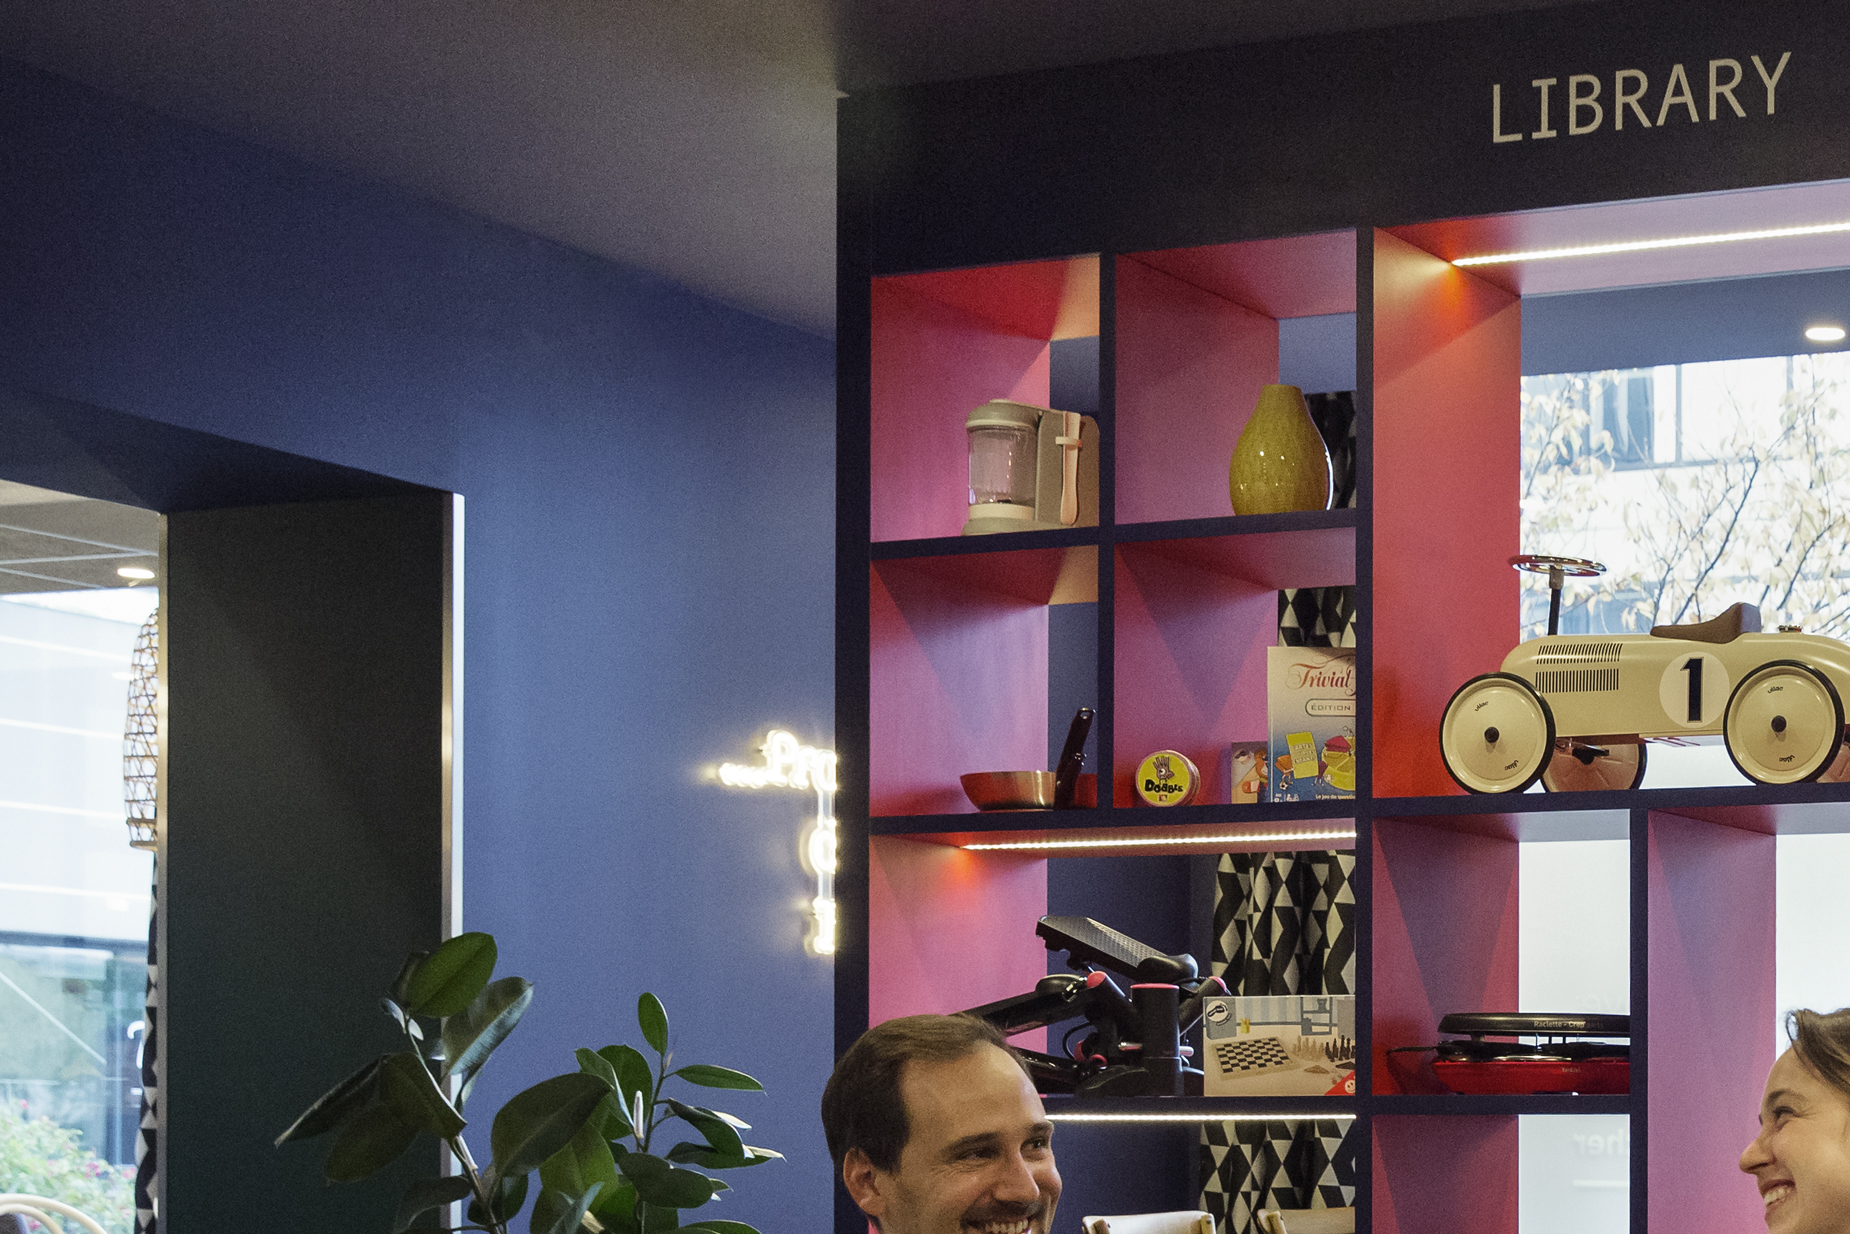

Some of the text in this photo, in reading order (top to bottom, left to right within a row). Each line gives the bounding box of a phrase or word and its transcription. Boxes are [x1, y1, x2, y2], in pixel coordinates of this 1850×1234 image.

[1493, 51, 1792, 143] LIBRARY
[1286, 661, 1352, 690] Trivial
[1680, 656, 1704, 723] 1
[1311, 703, 1351, 711] ÉDITION
[1534, 1020, 1562, 1028] Raclette
